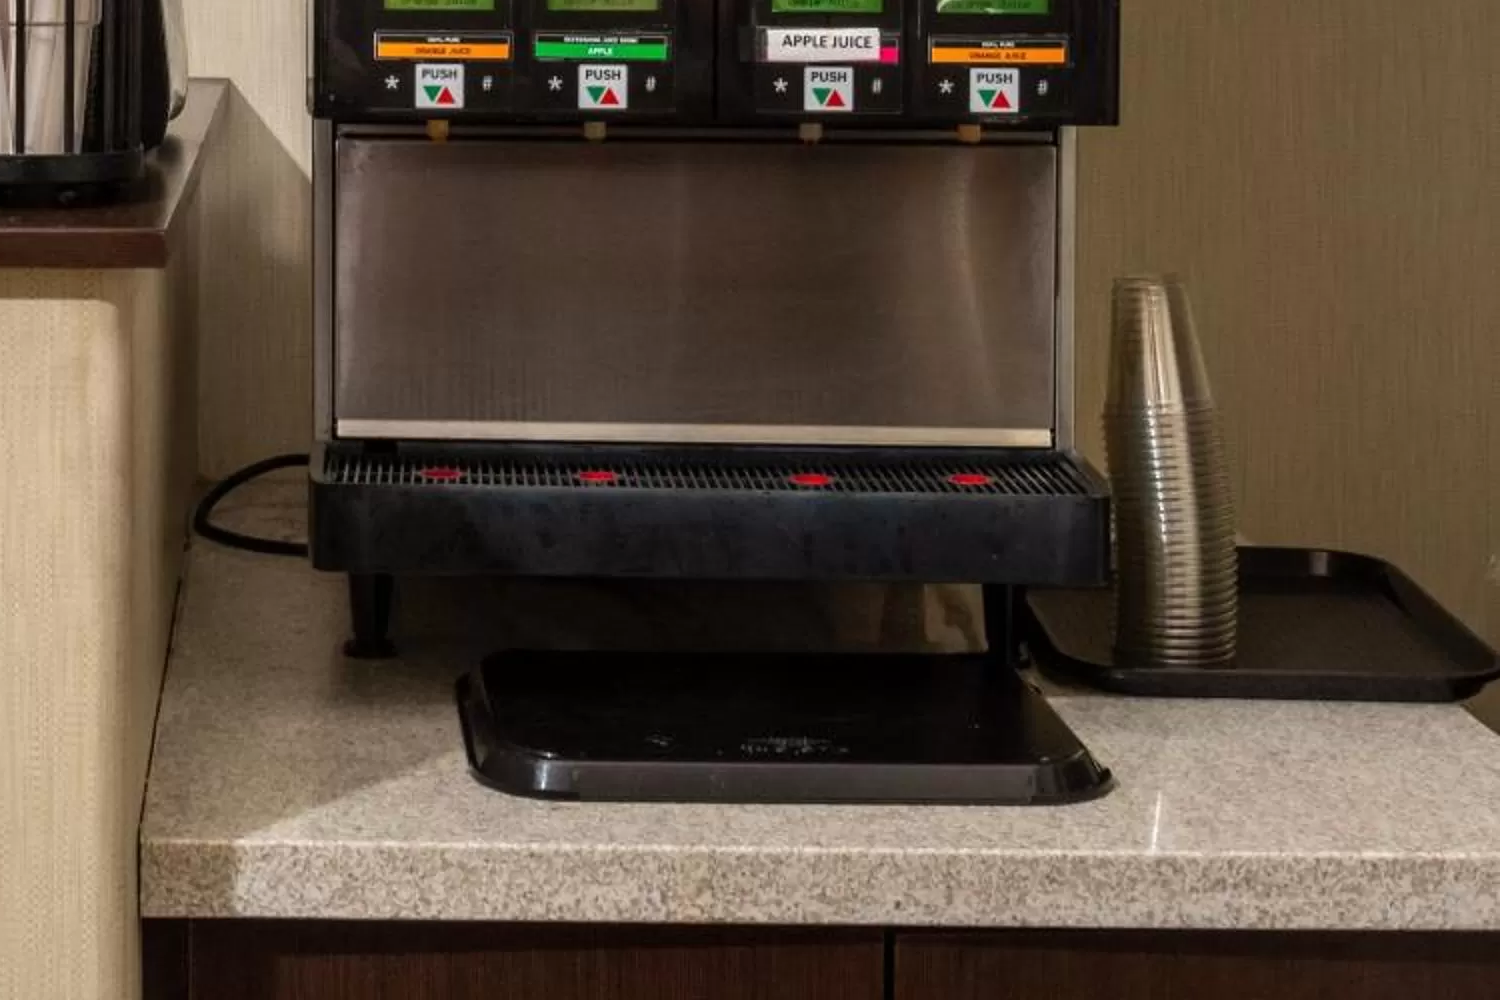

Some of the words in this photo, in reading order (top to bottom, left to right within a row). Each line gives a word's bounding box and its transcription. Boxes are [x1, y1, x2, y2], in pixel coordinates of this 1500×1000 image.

[782, 34, 829, 49] APPLE
[833, 35, 874, 49] JUICE
[422, 68, 457, 80] PUSH
[585, 69, 621, 81] PUSH
[811, 71, 847, 83] PUSH
[977, 73, 1013, 84] PUSH
